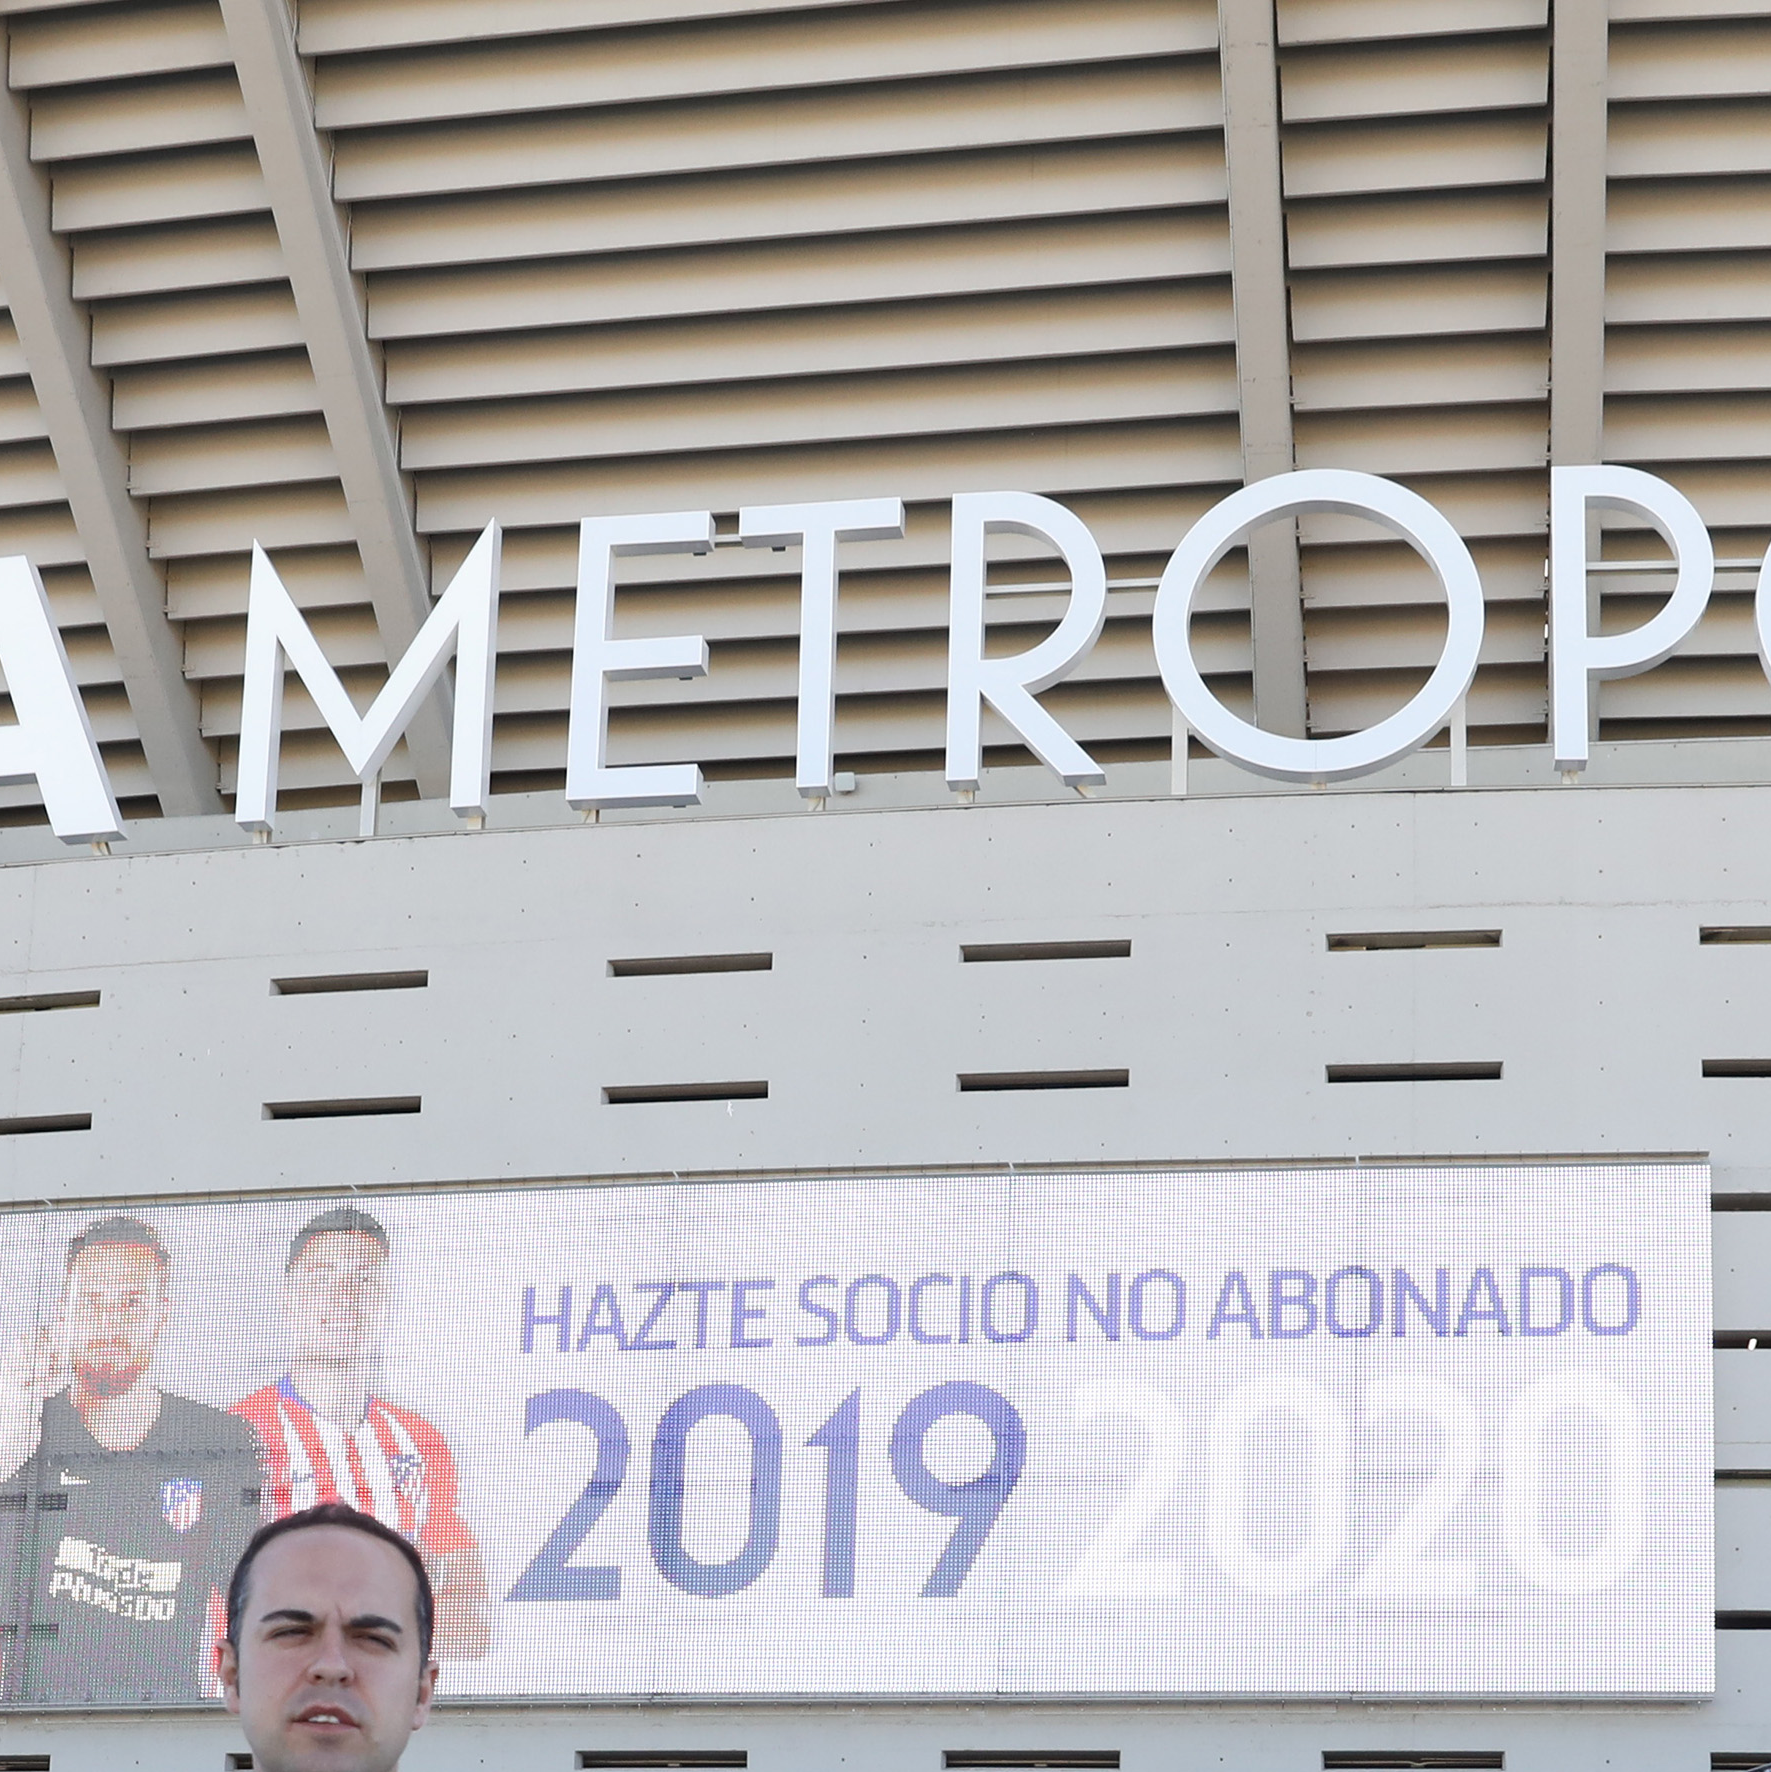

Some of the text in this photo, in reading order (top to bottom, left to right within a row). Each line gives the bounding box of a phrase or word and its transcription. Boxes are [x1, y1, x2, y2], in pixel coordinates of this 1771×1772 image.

[520, 1262, 1643, 1354] HAZTE SOCIO NO ABONADO
[505, 1370, 1648, 1600] 2019 2020
